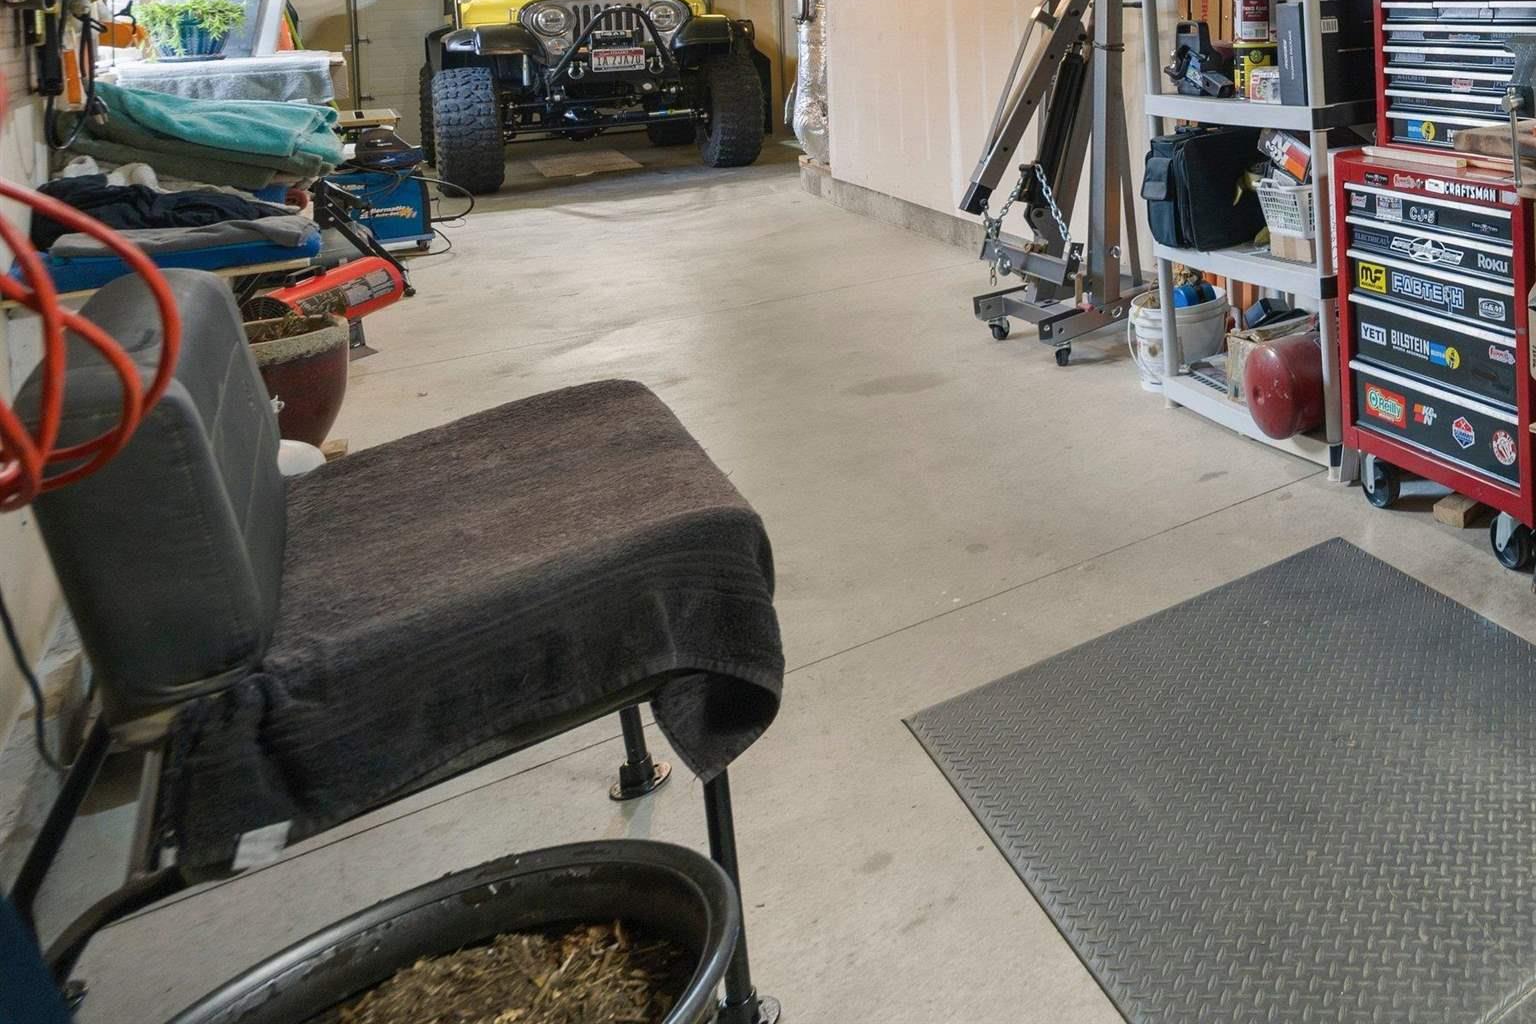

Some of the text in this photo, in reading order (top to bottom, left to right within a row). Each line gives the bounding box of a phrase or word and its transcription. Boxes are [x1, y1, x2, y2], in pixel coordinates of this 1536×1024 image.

[1443, 183, 1496, 202] CRAFTSMAN
[1392, 272, 1464, 308] FABTECH
[1362, 326, 1385, 343] YETI
[1391, 329, 1430, 355] BILSTEIN
